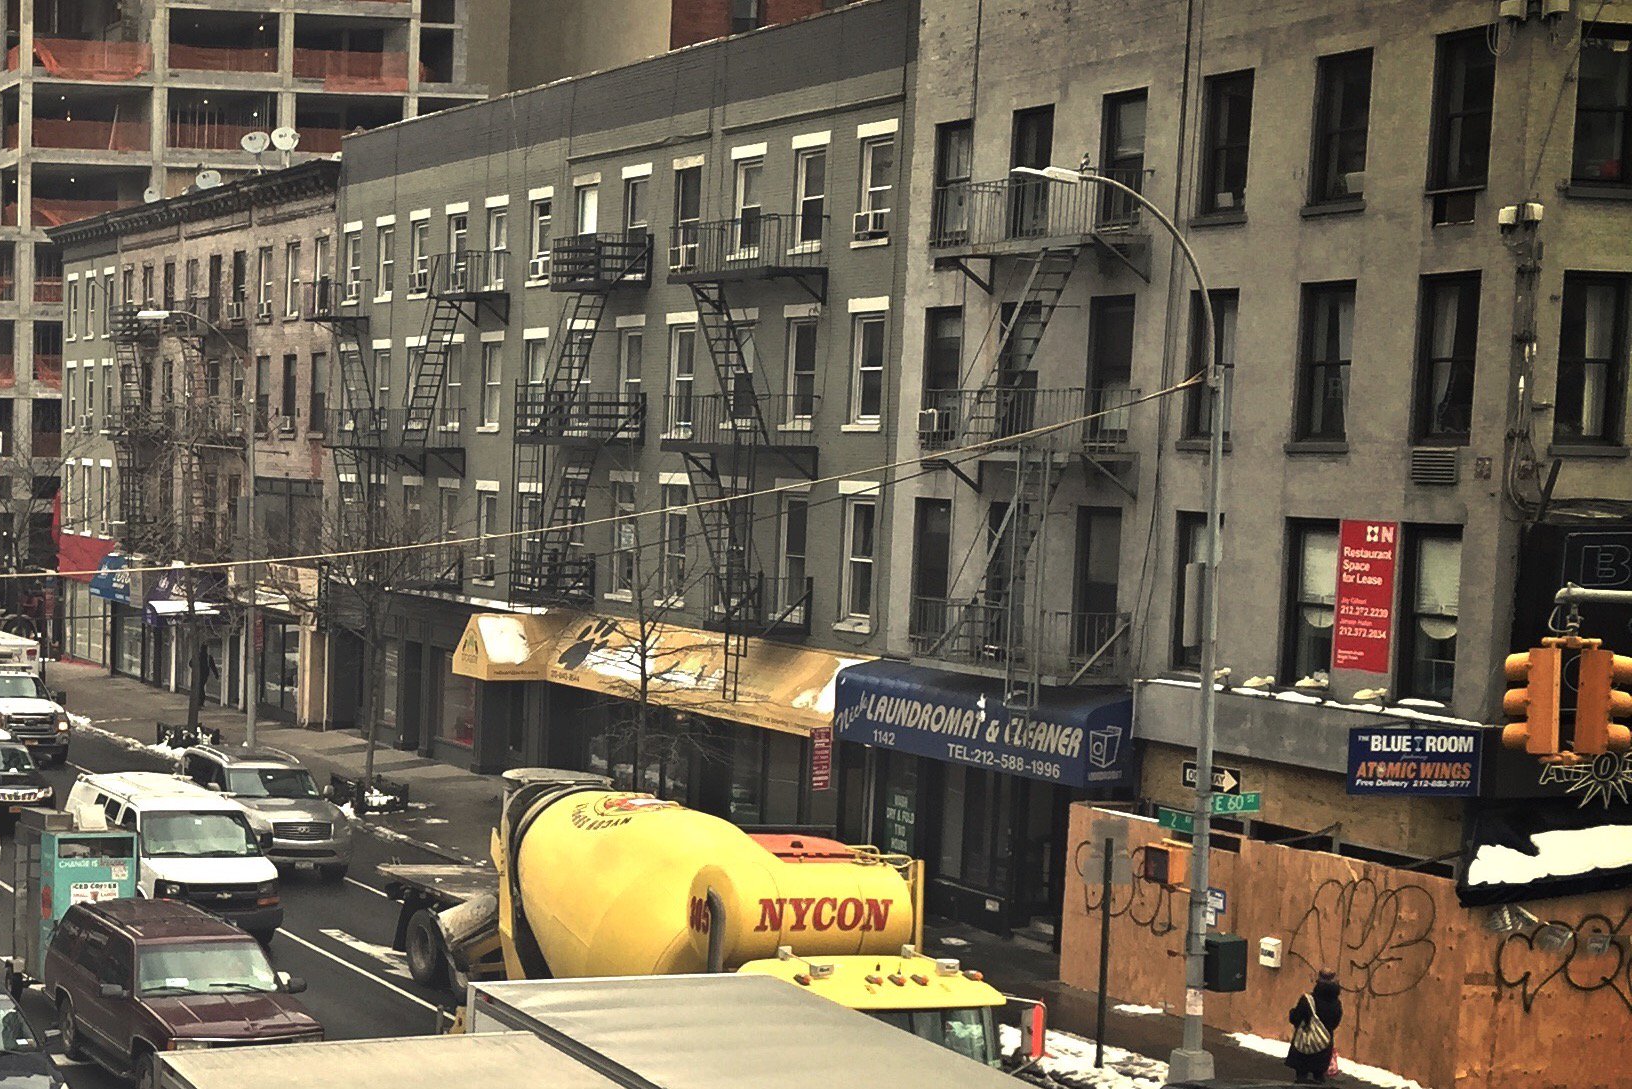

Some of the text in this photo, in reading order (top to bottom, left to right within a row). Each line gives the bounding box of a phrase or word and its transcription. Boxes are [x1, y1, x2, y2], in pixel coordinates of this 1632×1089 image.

[1343, 546, 1392, 560] Restaurant
[1342, 559, 1370, 572] Space
[1342, 572, 1383, 586] for Lease
[866, 693, 985, 740] LAUNDROMAT
[985, 720, 1000, 743] &
[1004, 717, 1084, 759] CLEANER
[872, 729, 896, 746] 1142
[1370, 735, 1412, 752] BLUE
[1425, 736, 1474, 753] ROOM
[1355, 761, 1472, 779] ATOMIC WINGS
[1355, 779, 1374, 787] Free
[1375, 779, 1409, 789] Delivery
[1215, 794, 1256, 811] E 60 ST
[1171, 813, 1177, 828] 2
[59, 860, 90, 868] CHANGE
[753, 897, 894, 932] NYCON
